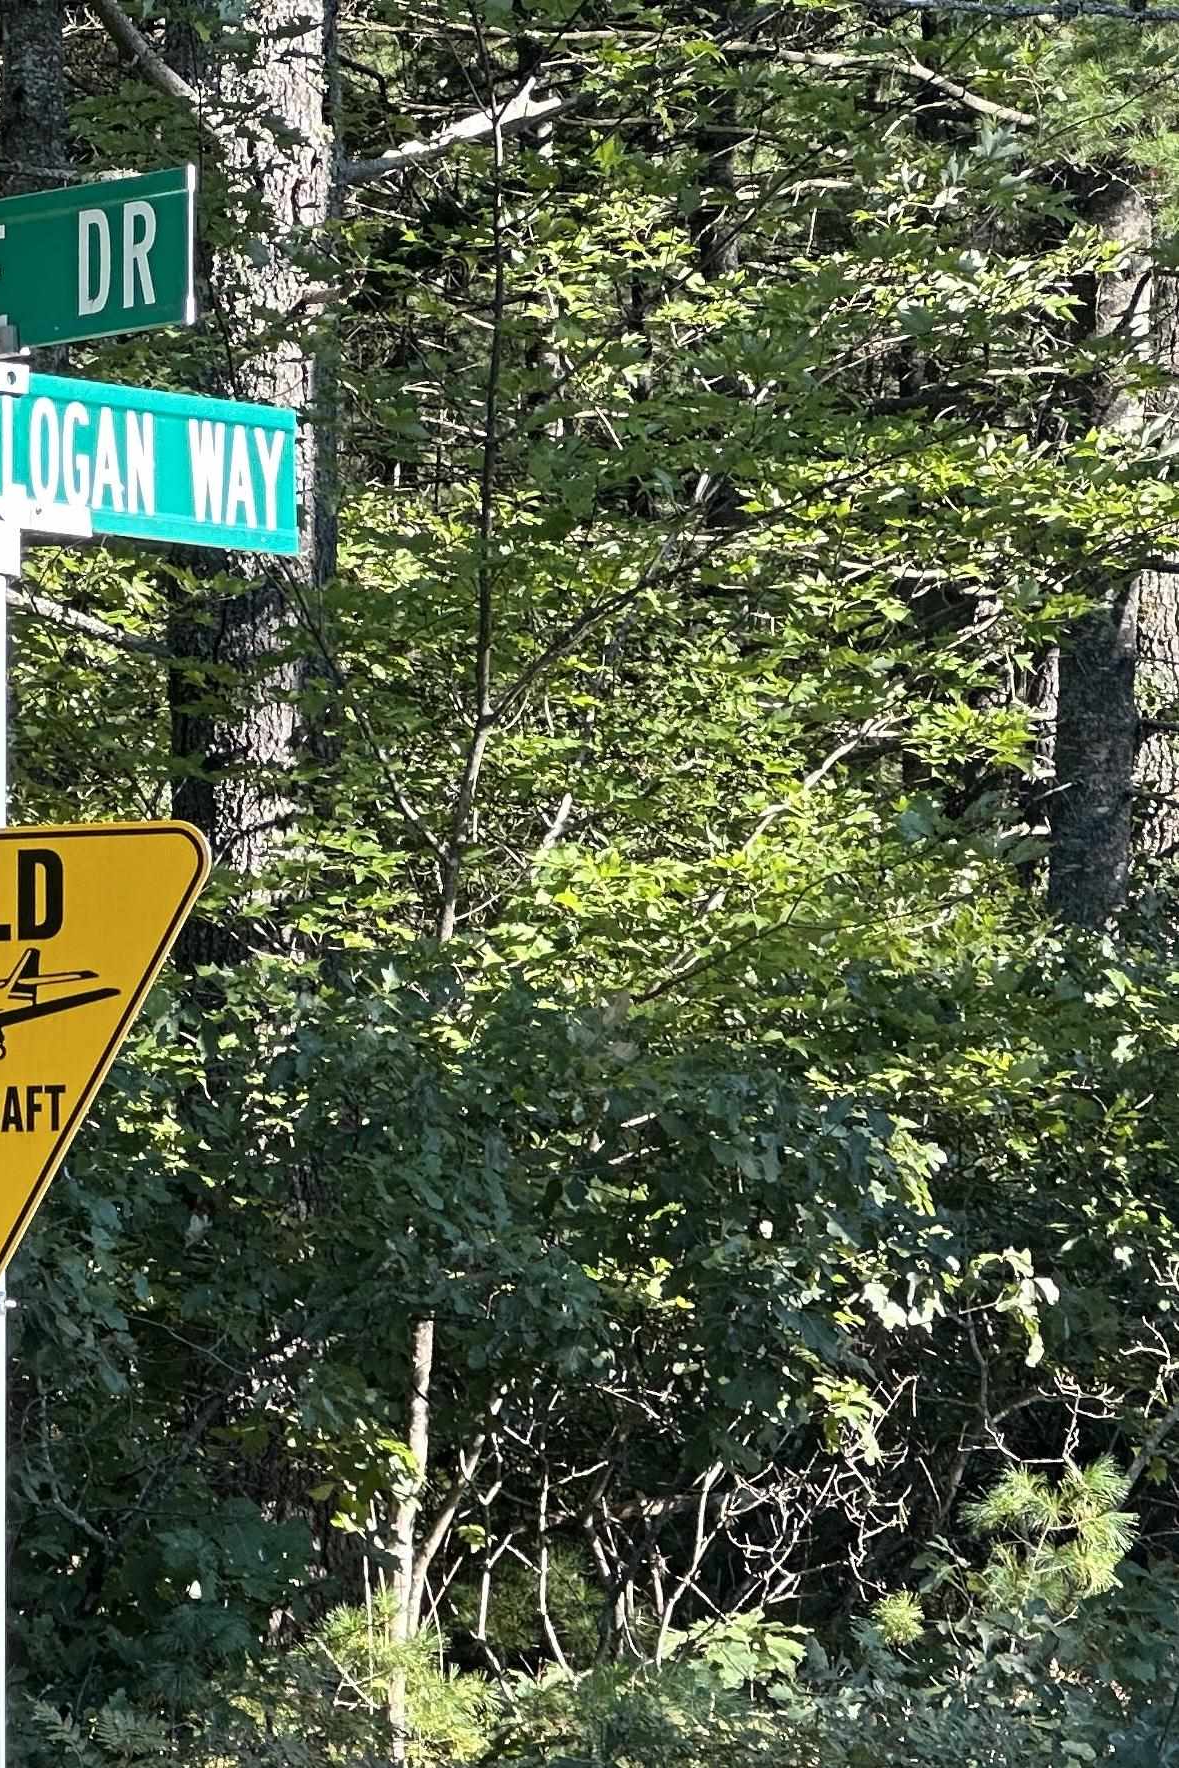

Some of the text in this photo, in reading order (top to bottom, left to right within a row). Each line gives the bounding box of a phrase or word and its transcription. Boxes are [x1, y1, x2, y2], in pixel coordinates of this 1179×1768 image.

[78, 200, 158, 316] DR
[1, 394, 155, 516] LOGAN
[188, 418, 284, 531] WAY
